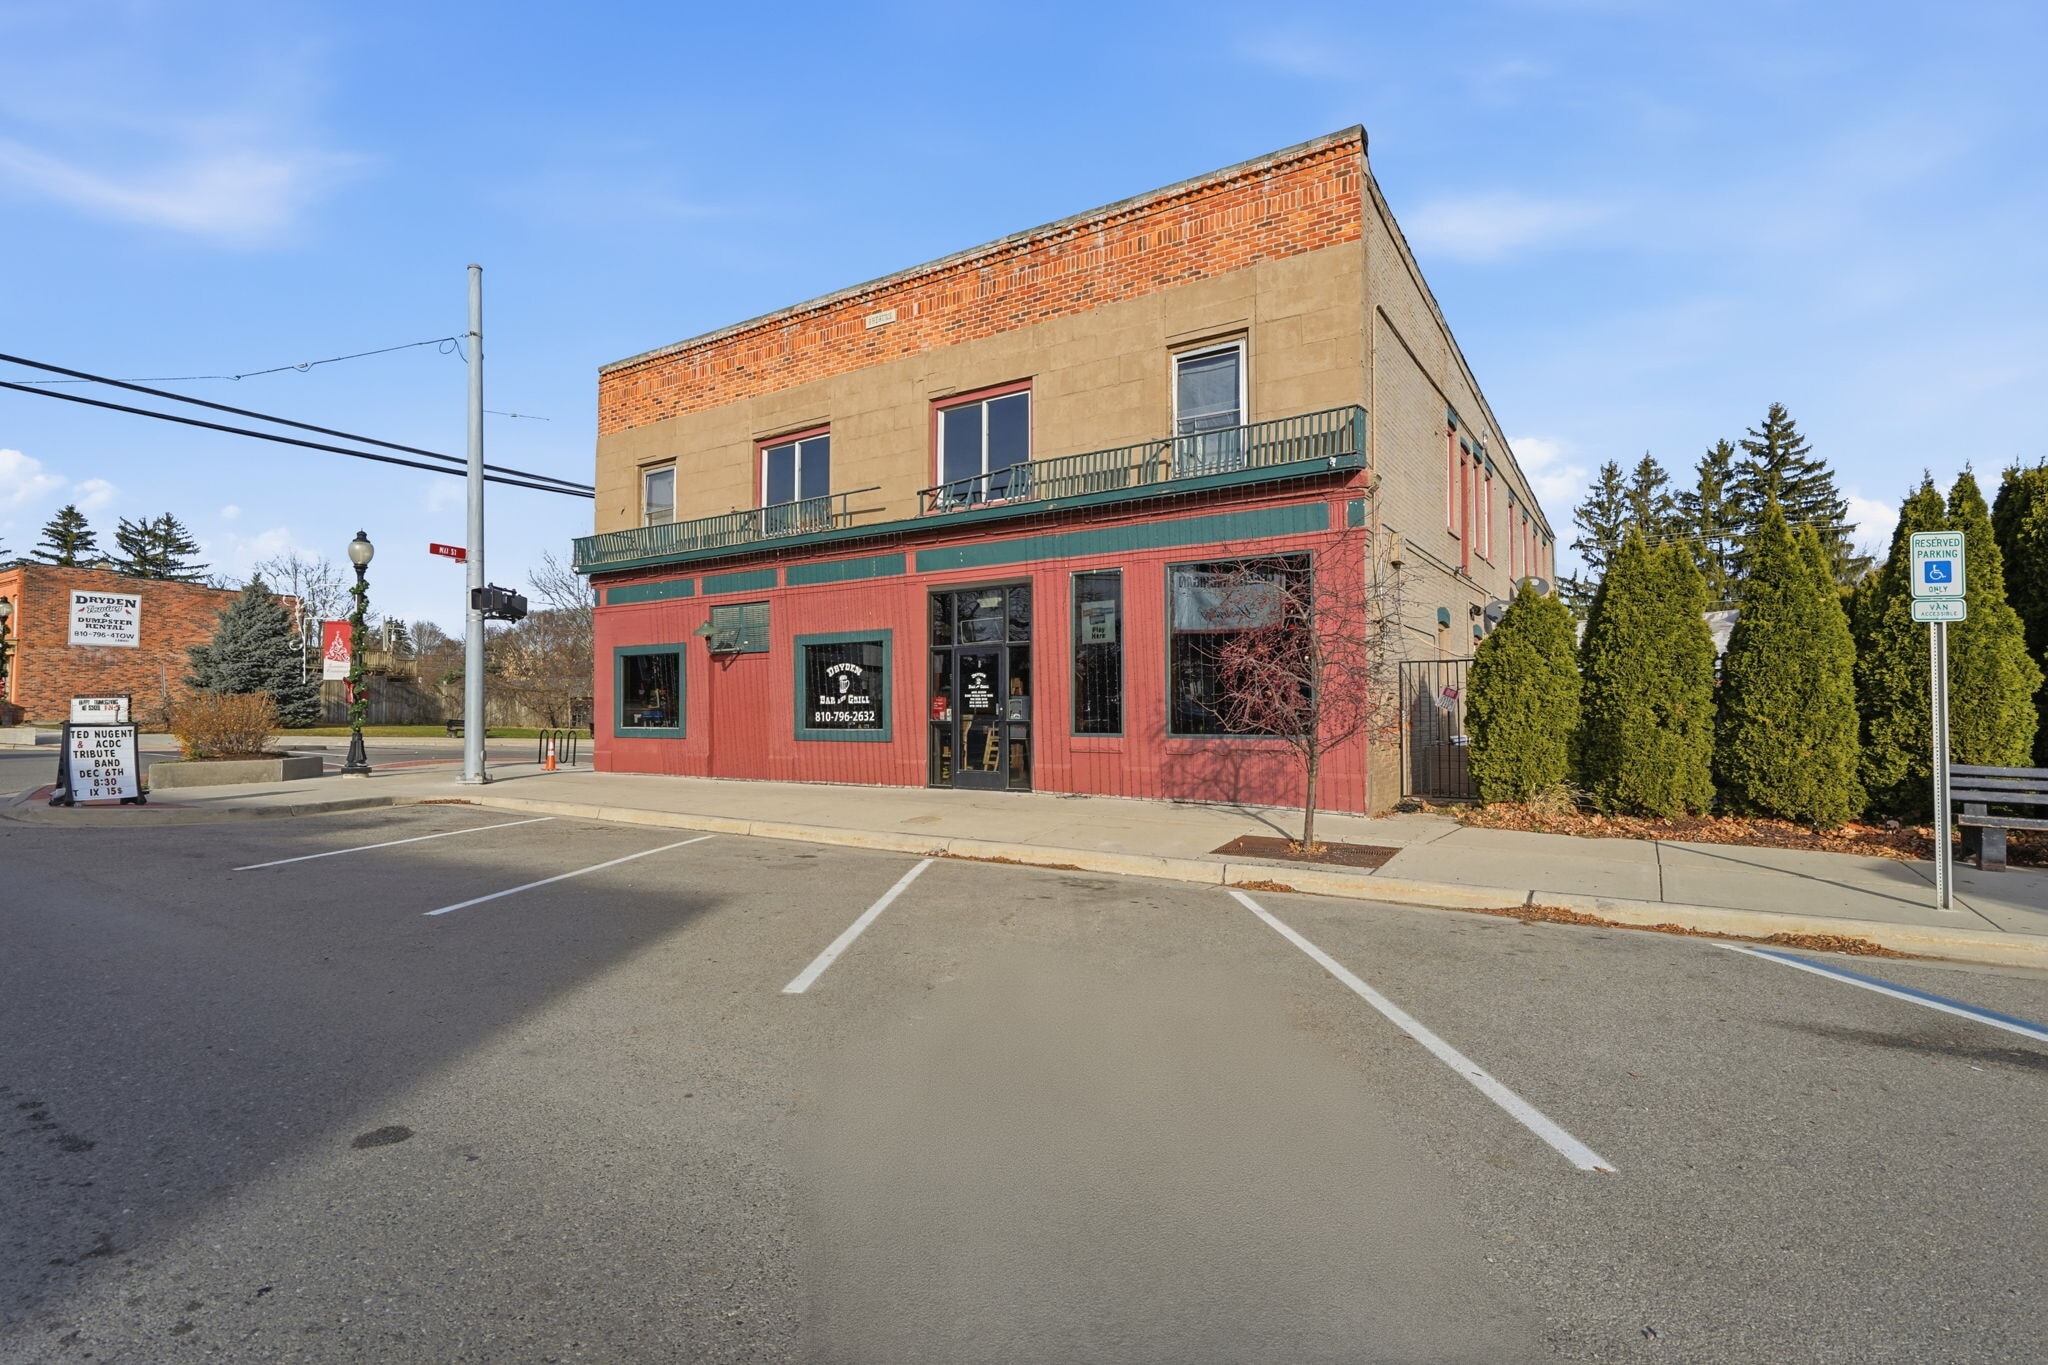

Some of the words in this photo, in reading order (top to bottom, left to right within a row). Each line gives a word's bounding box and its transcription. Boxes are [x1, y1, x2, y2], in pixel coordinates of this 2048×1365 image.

[1914, 538, 1961, 548] RESERVED
[1917, 549, 1959, 559] PARKING
[75, 595, 137, 609] DRYDEN
[1929, 603, 1949, 611] VAN
[78, 617, 133, 626] DUMPSTER
[85, 623, 125, 631] RENTAL
[74, 630, 135, 640] 810-796-4TOW
[826, 662, 863, 678] DRYDEN
[819, 695, 836, 705] BAR
[847, 694, 870, 705] GRILL
[814, 710, 875, 722] 810-796-2632
[70, 730, 90, 739] TED
[94, 729, 133, 739] NUGENT
[77, 740, 84, 749] &
[95, 739, 122, 749] ACDC
[73, 749, 116, 759] TRIBUTE
[94, 758, 121, 768] BAND
[80, 769, 100, 779] DEC
[104, 768, 124, 777] 6TH
[93, 777, 117, 787] 8:30
[106, 787, 123, 796] 15$
